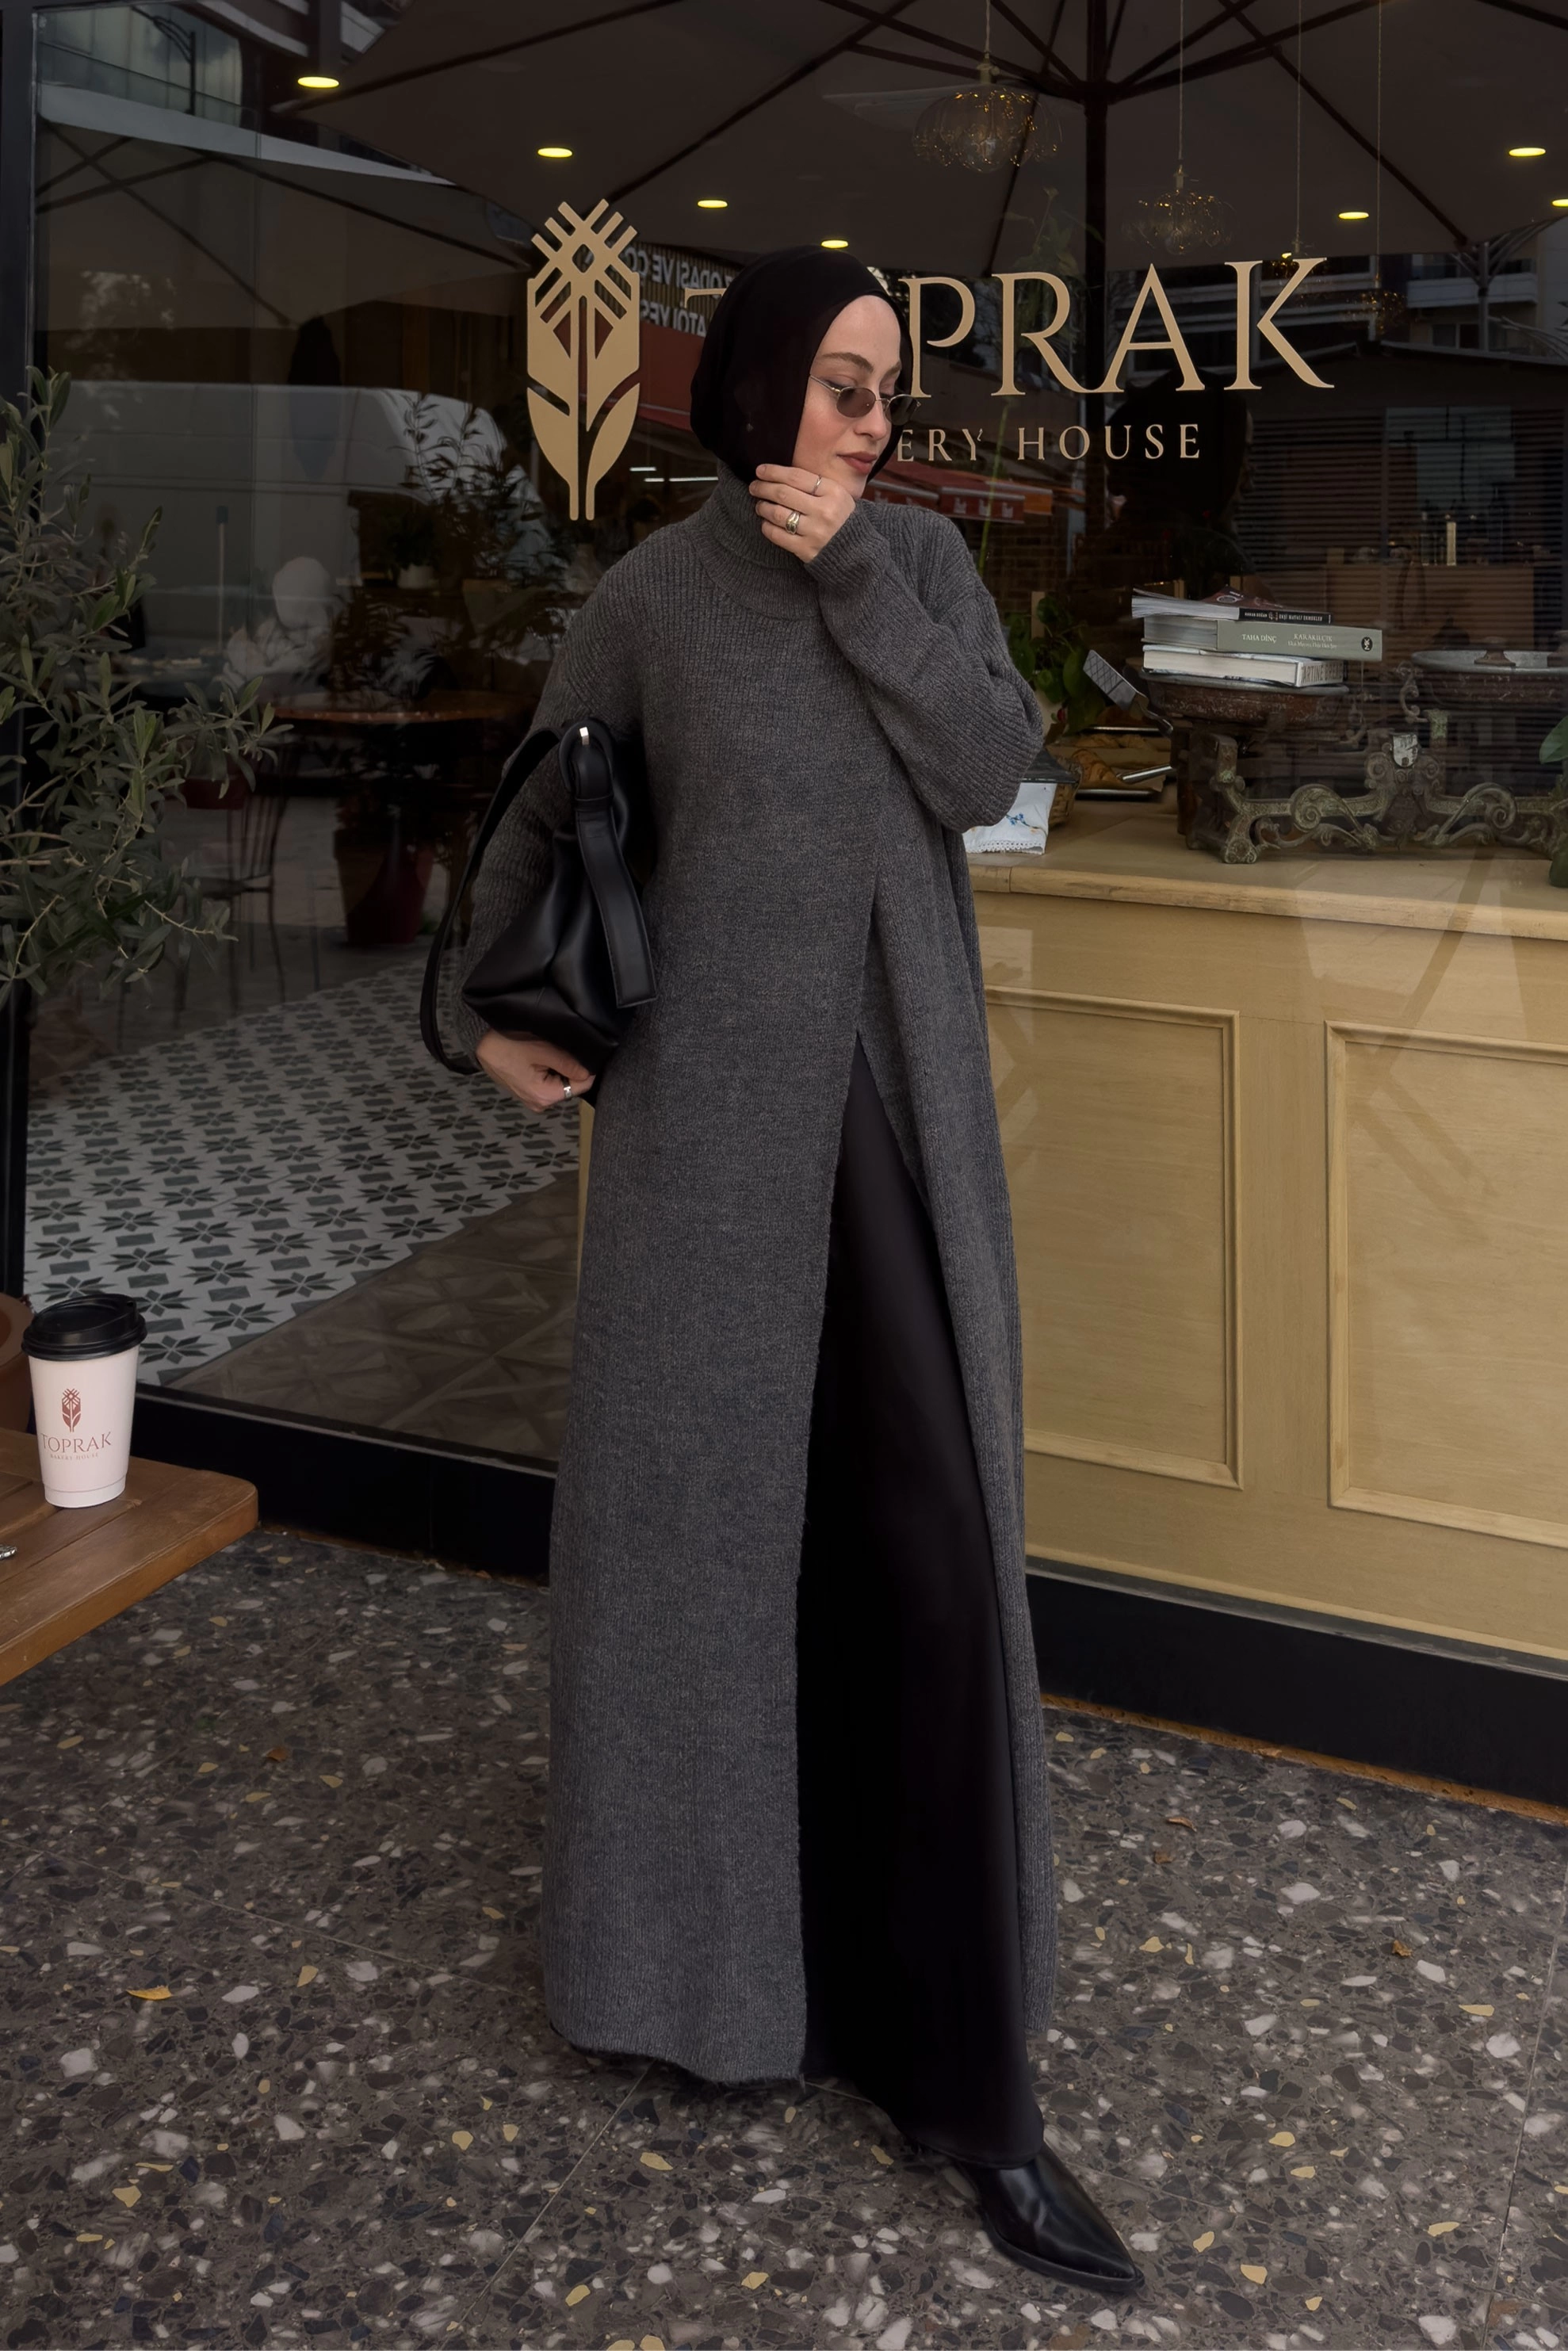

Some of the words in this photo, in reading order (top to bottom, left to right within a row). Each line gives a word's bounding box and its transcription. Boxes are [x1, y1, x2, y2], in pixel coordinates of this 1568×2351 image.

[684, 256, 1335, 398] PRAK
[897, 428, 983, 461] ERY
[1017, 423, 1200, 461] HOUSE
[40, 1431, 111, 1453] TOPRAK
